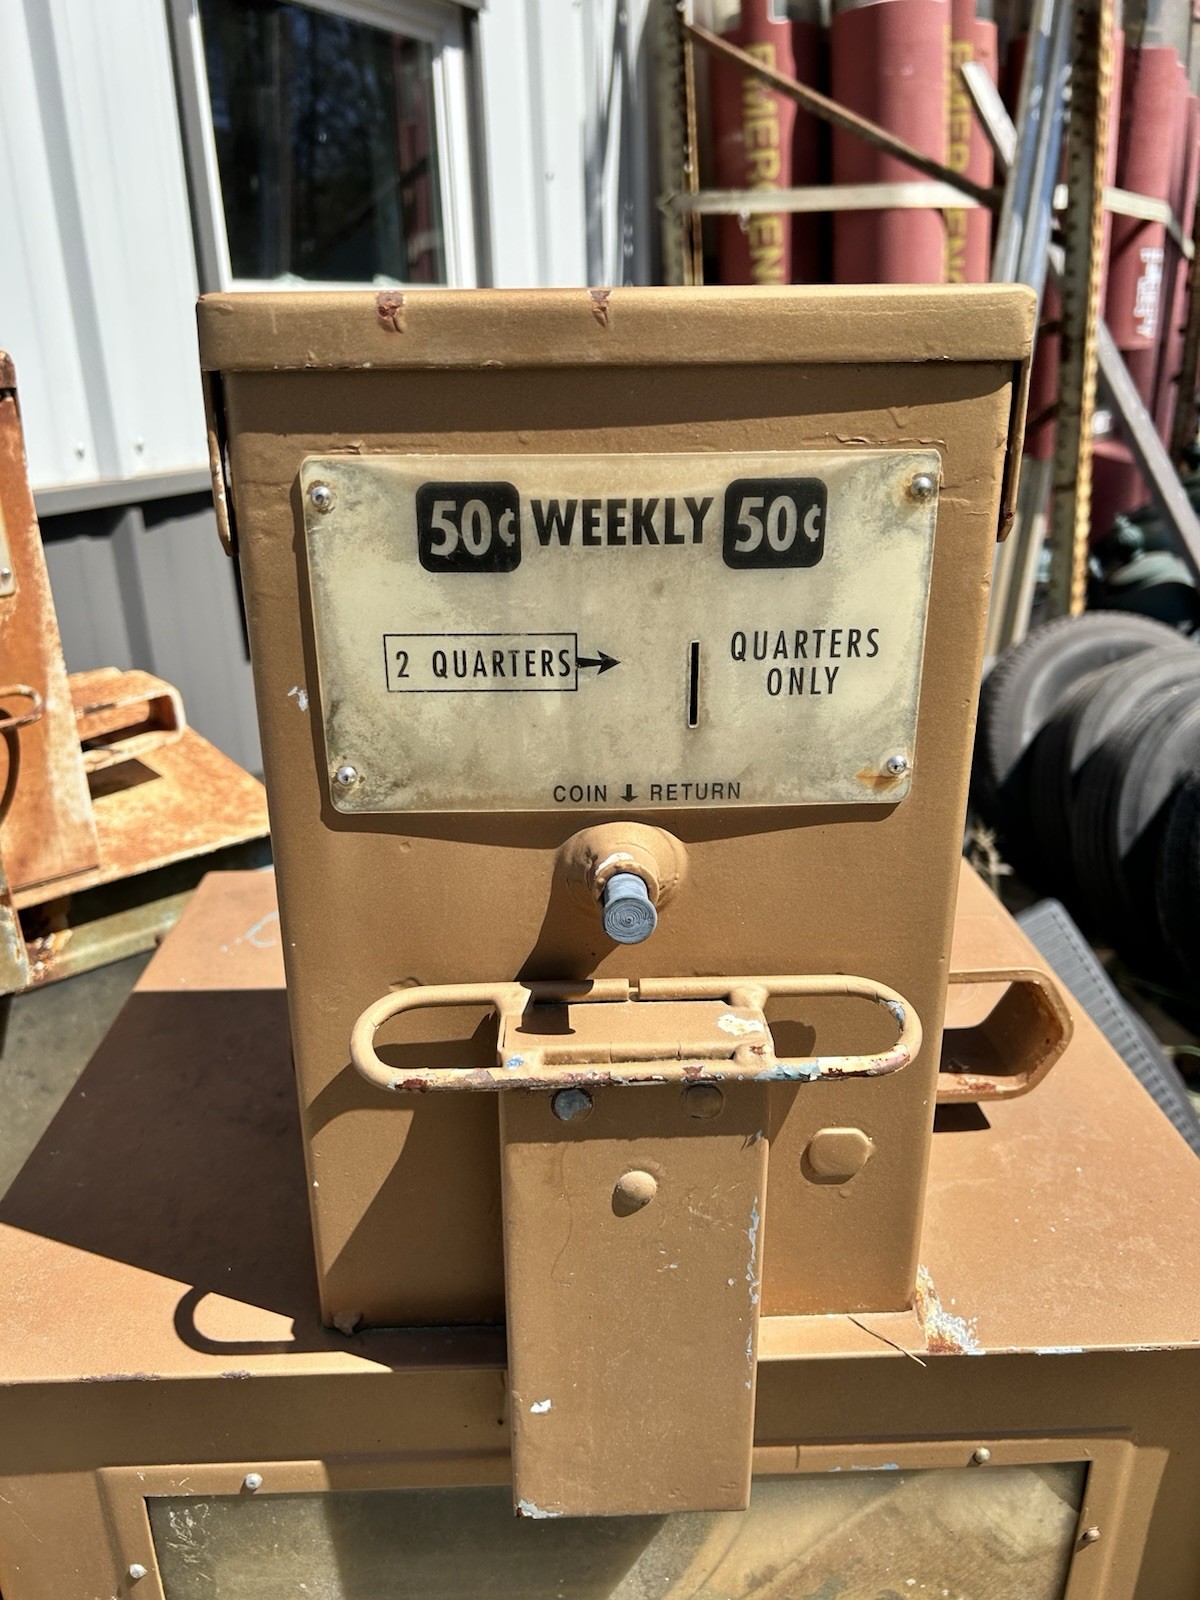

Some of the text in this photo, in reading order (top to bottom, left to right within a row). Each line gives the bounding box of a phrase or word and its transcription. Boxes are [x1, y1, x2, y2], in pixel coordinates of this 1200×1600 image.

[430, 495, 822, 556] 50¢ WEEKLY 50¢
[730, 628, 880, 662] QUARTERS
[396, 649, 571, 679] 2 QUARTERS
[767, 666, 840, 696] ONLY
[553, 782, 741, 803] COIN RETURN
